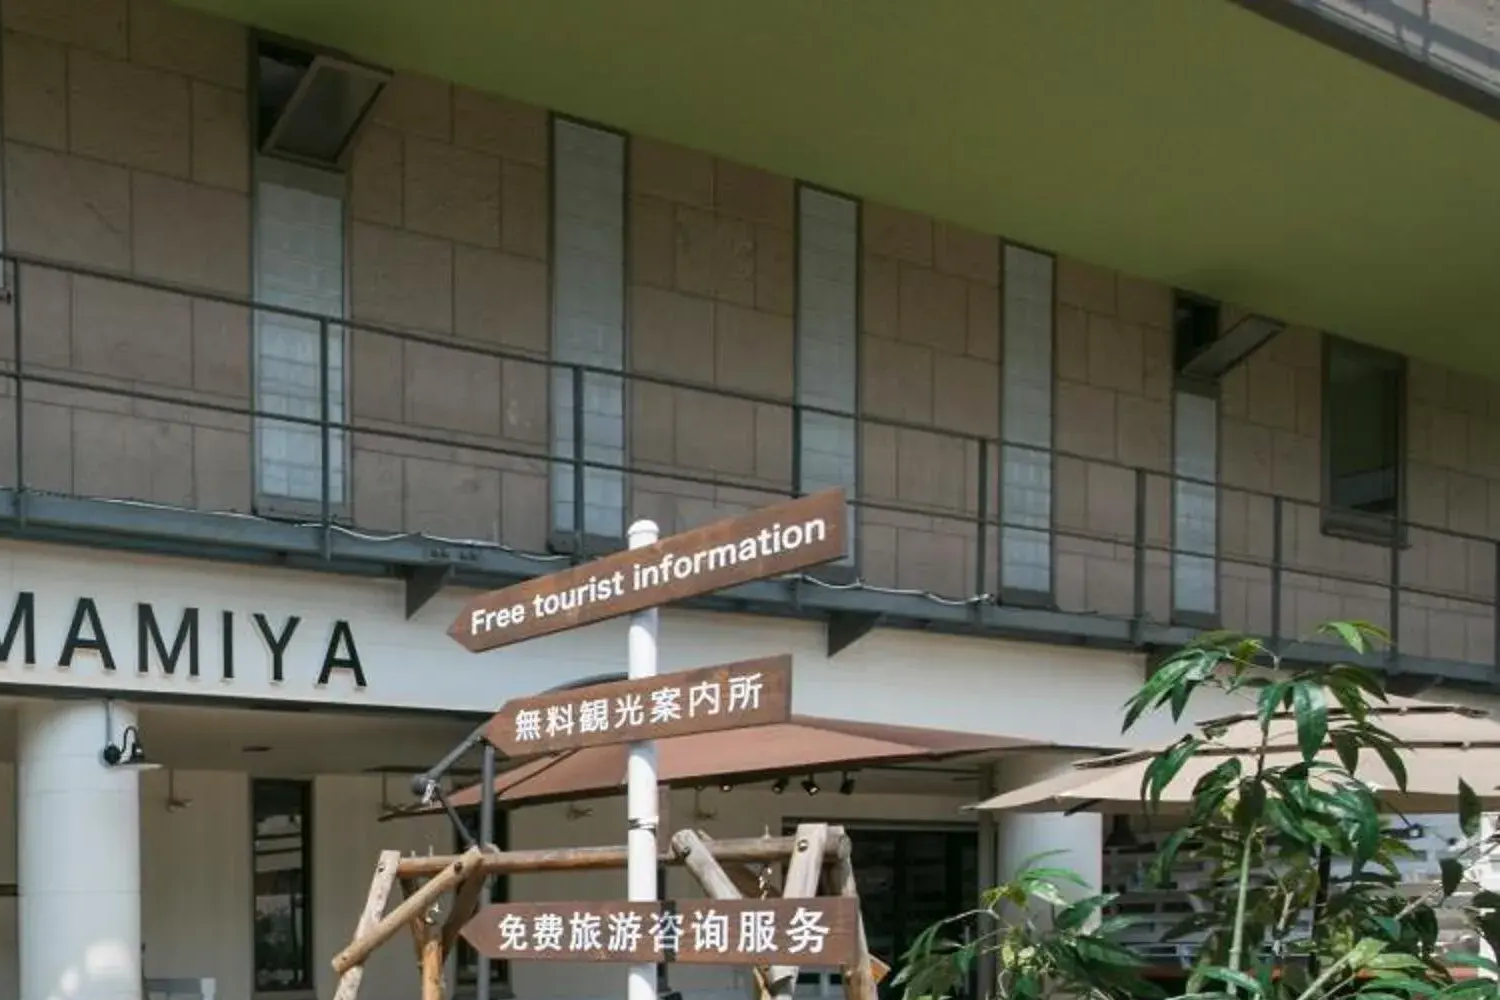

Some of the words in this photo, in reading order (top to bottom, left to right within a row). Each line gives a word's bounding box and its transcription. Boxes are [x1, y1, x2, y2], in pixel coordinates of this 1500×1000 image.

[471, 605, 526, 636] Free
[532, 570, 625, 619] tourist
[633, 517, 826, 591] information
[515, 671, 764, 742] 無料観光案内所
[497, 906, 831, 954] 免费旅游咨询服务
